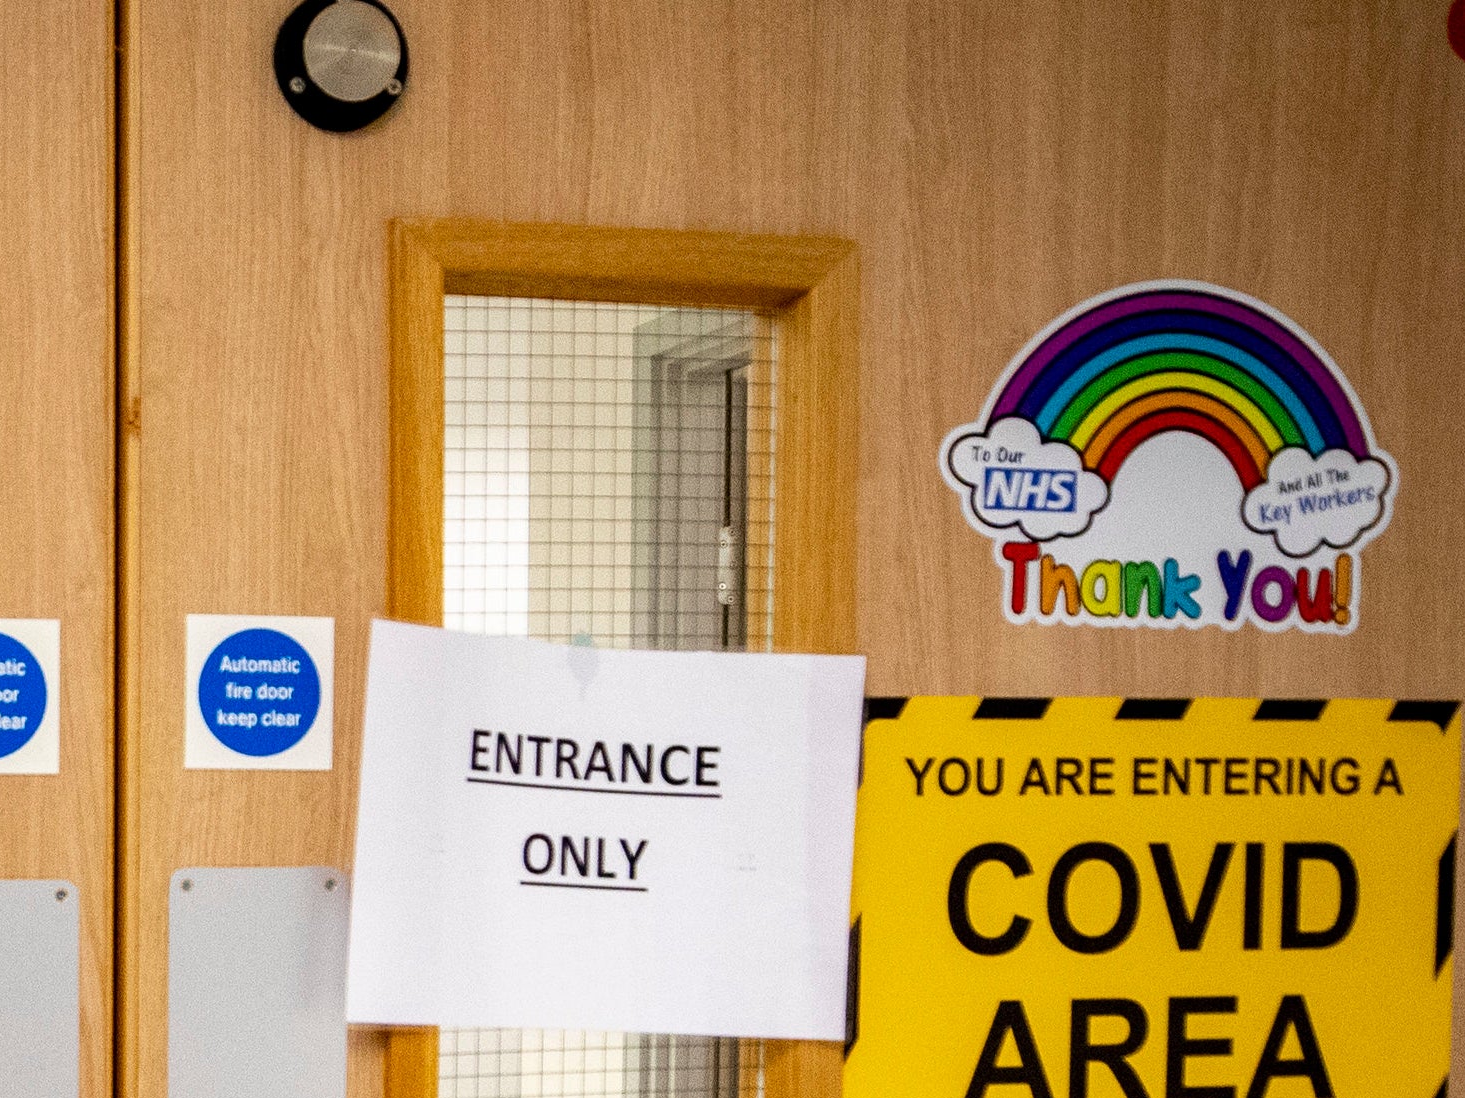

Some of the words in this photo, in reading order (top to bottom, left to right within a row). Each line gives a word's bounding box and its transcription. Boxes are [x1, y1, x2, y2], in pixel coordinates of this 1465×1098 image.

[972, 446, 991, 462] To
[995, 448, 1026, 463] Our
[986, 472, 1074, 509] NHS
[1278, 480, 1303, 495] And
[1306, 475, 1323, 492] All
[1326, 470, 1350, 487] The
[1260, 503, 1292, 525] Key
[1299, 486, 1375, 515] Workers
[1002, 541, 1202, 619] Thank
[1216, 548, 1352, 626] You!
[219, 655, 300, 676] Automatic
[226, 684, 253, 701] fire
[256, 684, 294, 701] door
[216, 709, 258, 729] keep
[261, 709, 301, 727] clear
[470, 728, 722, 788] ENTRANCE
[905, 756, 1005, 798] YOU
[1019, 756, 1115, 798] ARE
[1133, 756, 1361, 797] ENTERING
[1373, 758, 1404, 797] A
[522, 833, 649, 881] ONLY
[947, 840, 1361, 957] COVID
